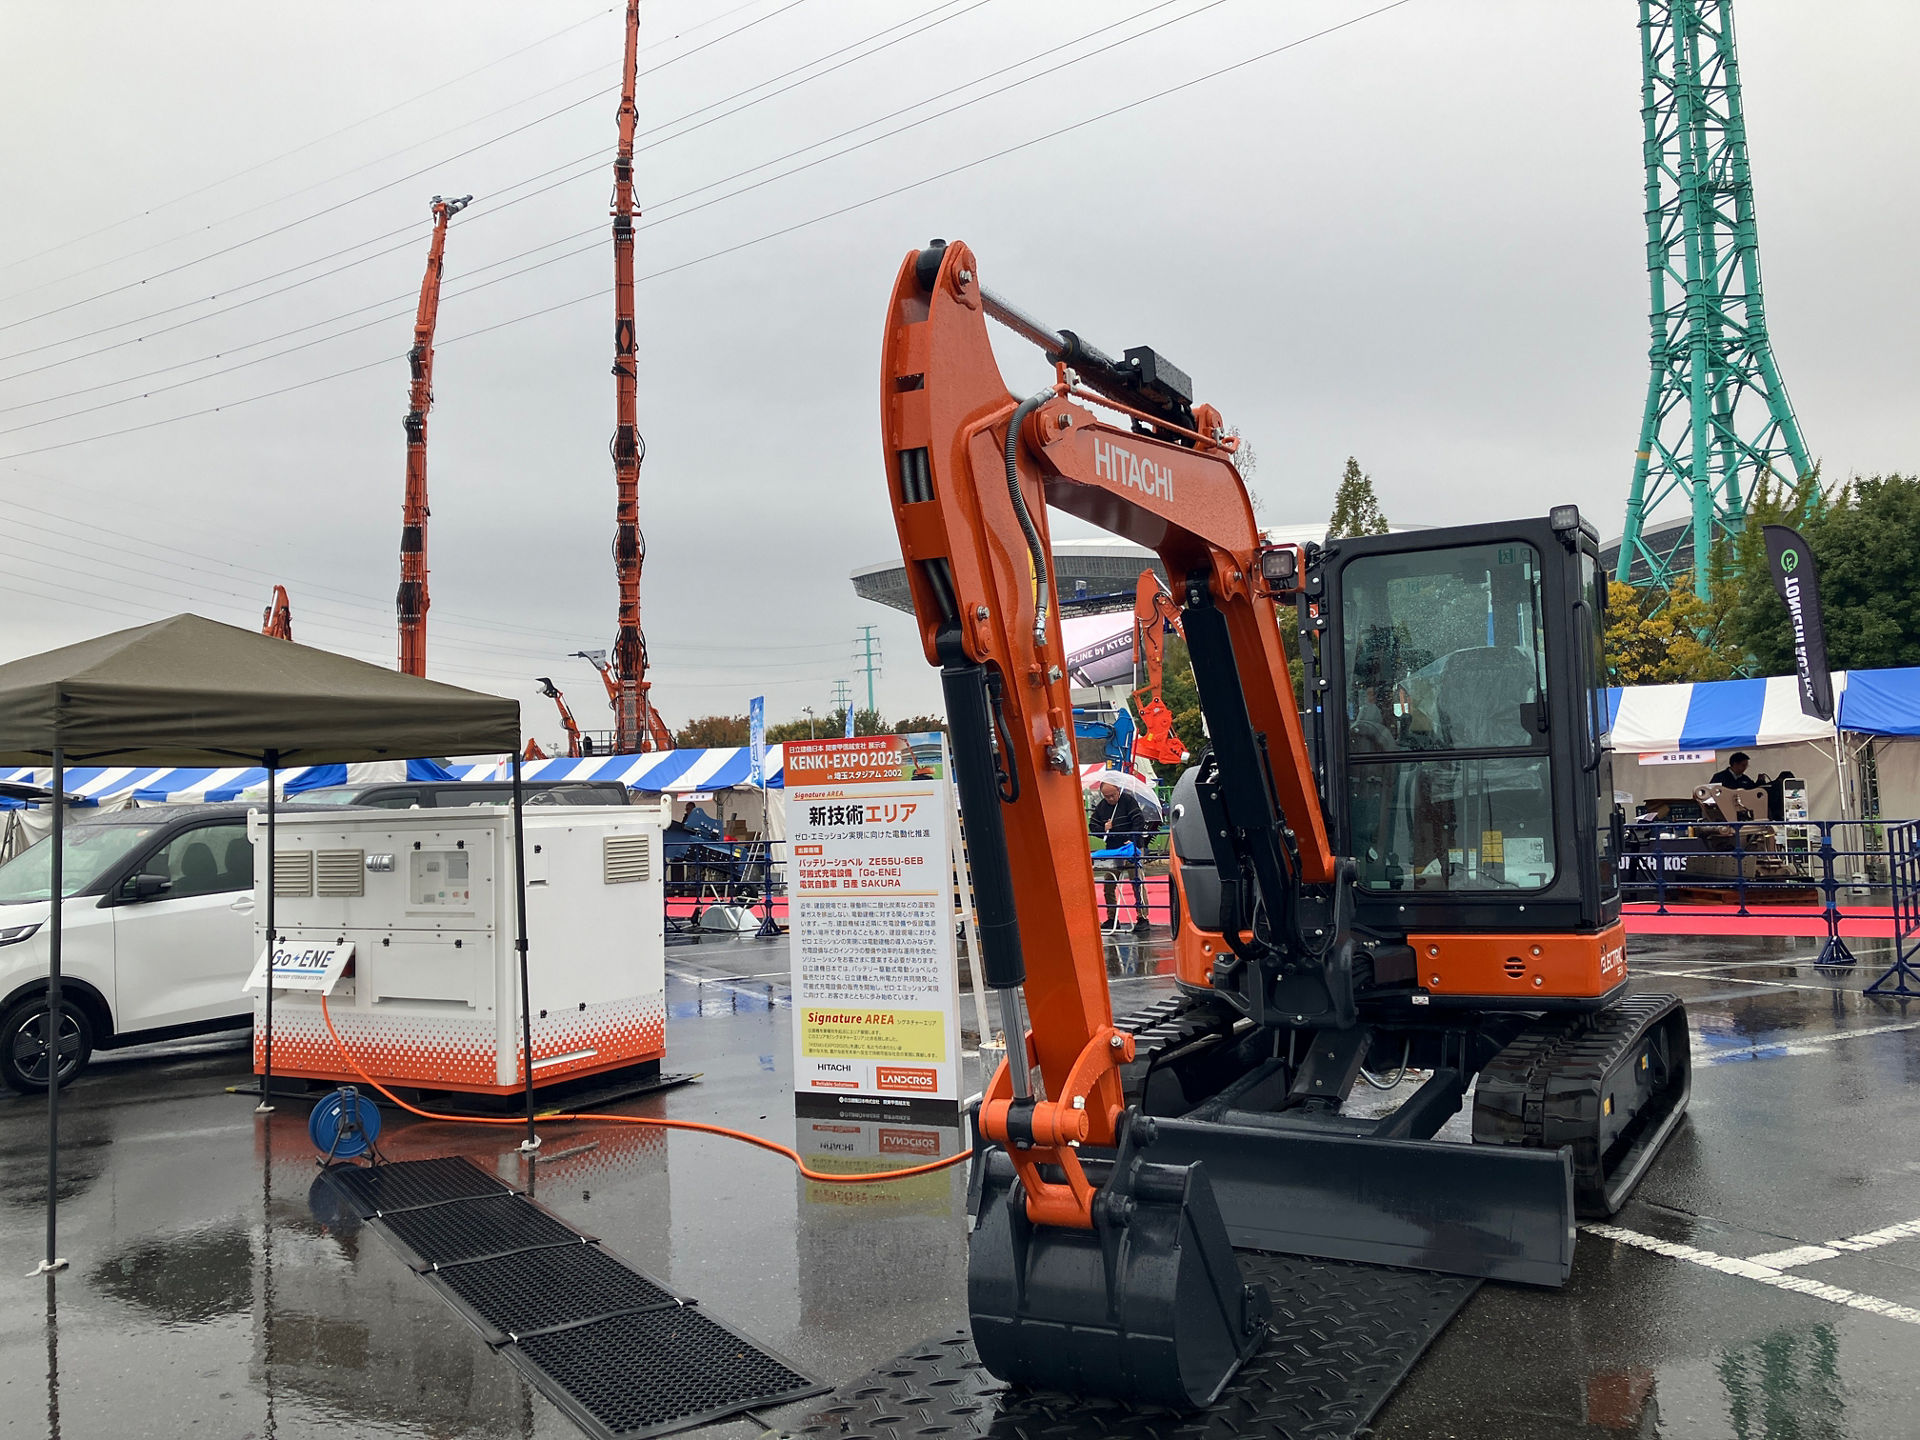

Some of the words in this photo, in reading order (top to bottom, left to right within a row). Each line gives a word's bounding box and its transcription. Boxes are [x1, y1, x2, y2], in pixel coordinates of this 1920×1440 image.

[1094, 437, 1174, 502] HITACHI
[1095, 646, 1105, 657] by
[1106, 634, 1133, 652] KTEG
[790, 752, 868, 770] KENKI-EXPO
[870, 751, 902, 766] 2025
[834, 771, 882, 780] 埼玉スタジアム
[883, 769, 902, 777] 2002
[794, 791, 826, 799] Signature
[809, 804, 917, 826] 新技術エリア
[799, 858, 863, 867] バッテリーショベル
[868, 857, 924, 866] ZE55U-6EB
[799, 880, 838, 889] 電気自動車
[843, 879, 859, 888] 日産
[861, 879, 901, 887] SAKURA
[807, 1012, 862, 1026] Signature
[864, 1014, 895, 1025] AREA
[817, 1063, 851, 1072] HITACHI
[881, 1074, 933, 1086] LANDCROS
